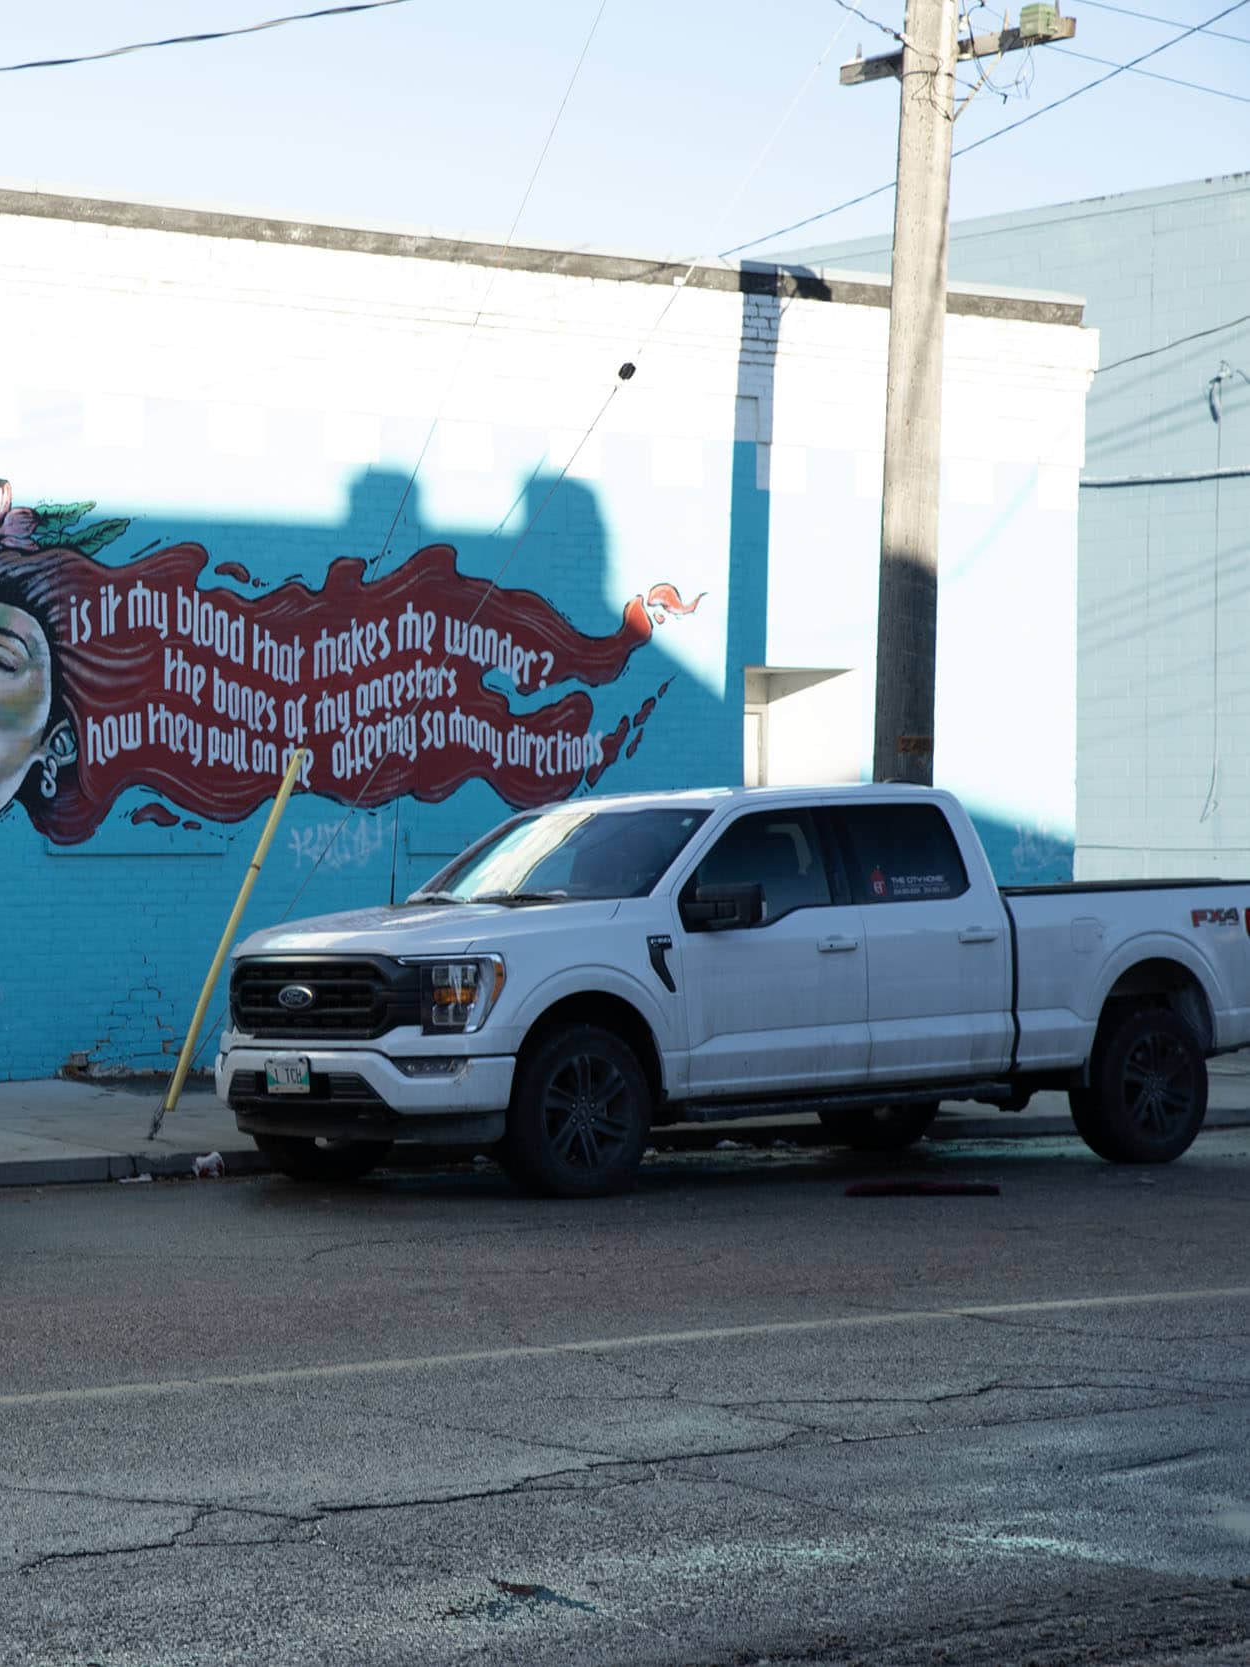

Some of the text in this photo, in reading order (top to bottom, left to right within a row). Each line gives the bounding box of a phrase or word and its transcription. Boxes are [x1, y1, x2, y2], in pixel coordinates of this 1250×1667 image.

[69, 580, 555, 690] is it my blood that makes me wander?
[164, 647, 457, 744] the bones of my ancestors
[87, 711, 142, 766] how
[148, 702, 202, 768] they
[207, 726, 250, 773] pull
[252, 738, 277, 775] on
[331, 712, 418, 780] offering
[421, 710, 445, 750] so
[449, 705, 502, 770] many
[507, 724, 604, 777] directions
[1191, 907, 1239, 928] FX4
